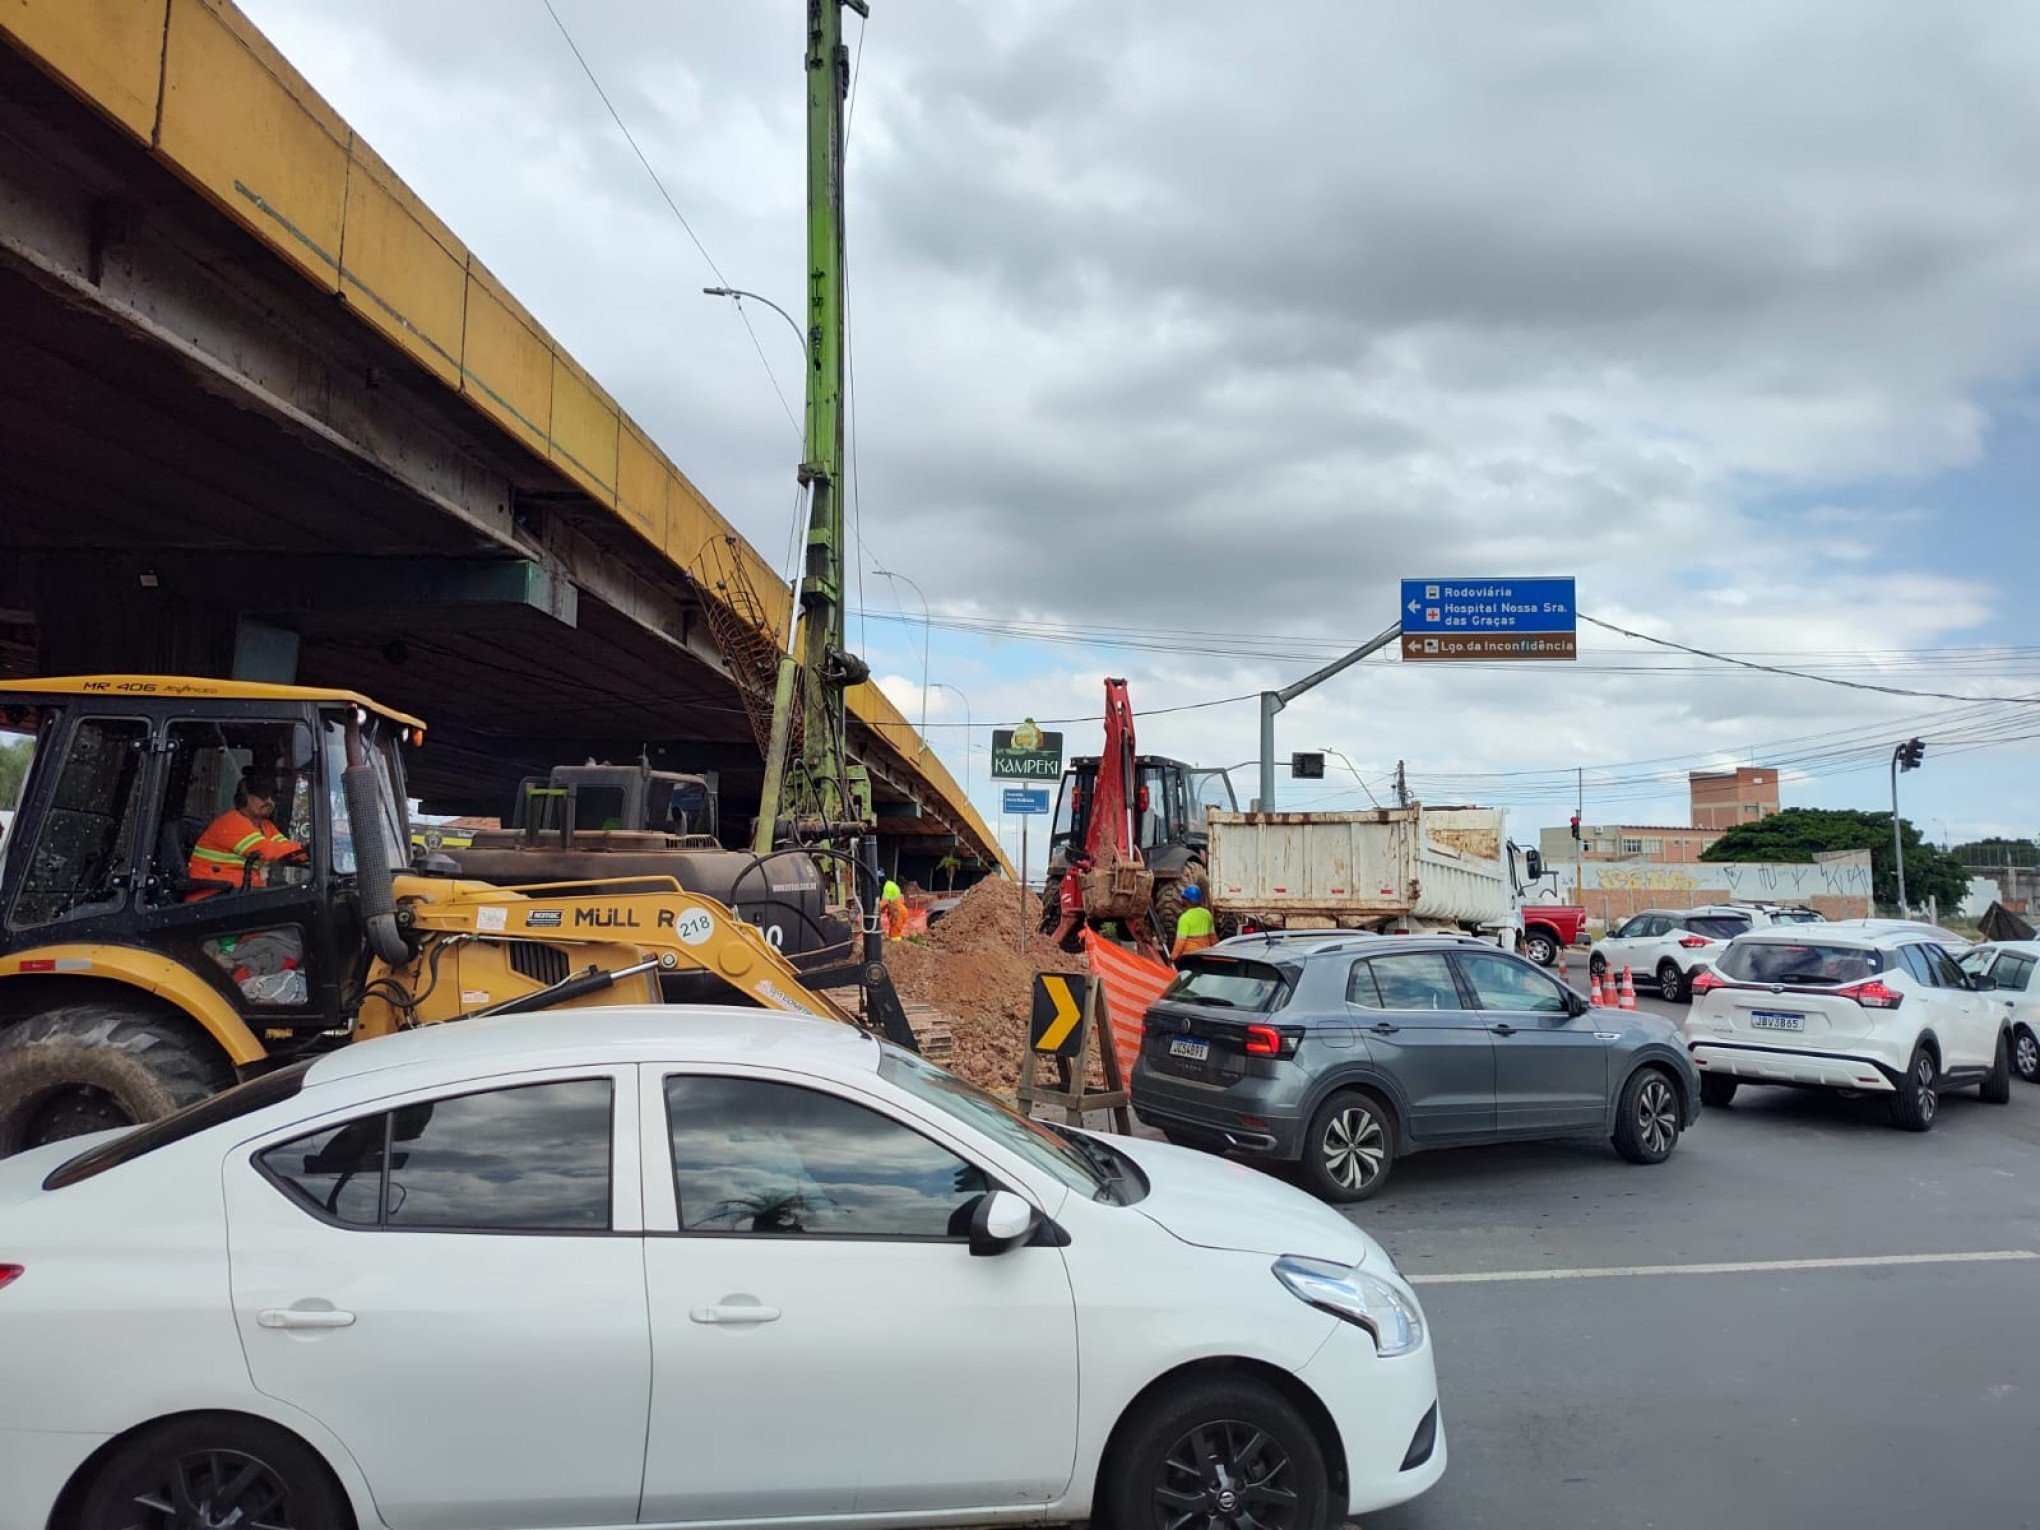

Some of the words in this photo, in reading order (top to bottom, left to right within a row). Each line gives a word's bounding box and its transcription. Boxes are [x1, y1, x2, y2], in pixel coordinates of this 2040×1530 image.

[1444, 586, 1512, 598] Rodoviária
[1444, 602, 1497, 615] Hospital
[1501, 602, 1538, 613] Nossa
[1543, 602, 1567, 613] Sra.
[1445, 616, 1467, 626] das
[1471, 616, 1516, 628] Graças
[1467, 640, 1481, 651] da
[1484, 640, 1573, 651] Inconfidência
[83, 682, 111, 691] MR
[116, 682, 157, 692] 406
[995, 757, 1058, 774] KAMPEKI
[680, 916, 710, 937] 218
